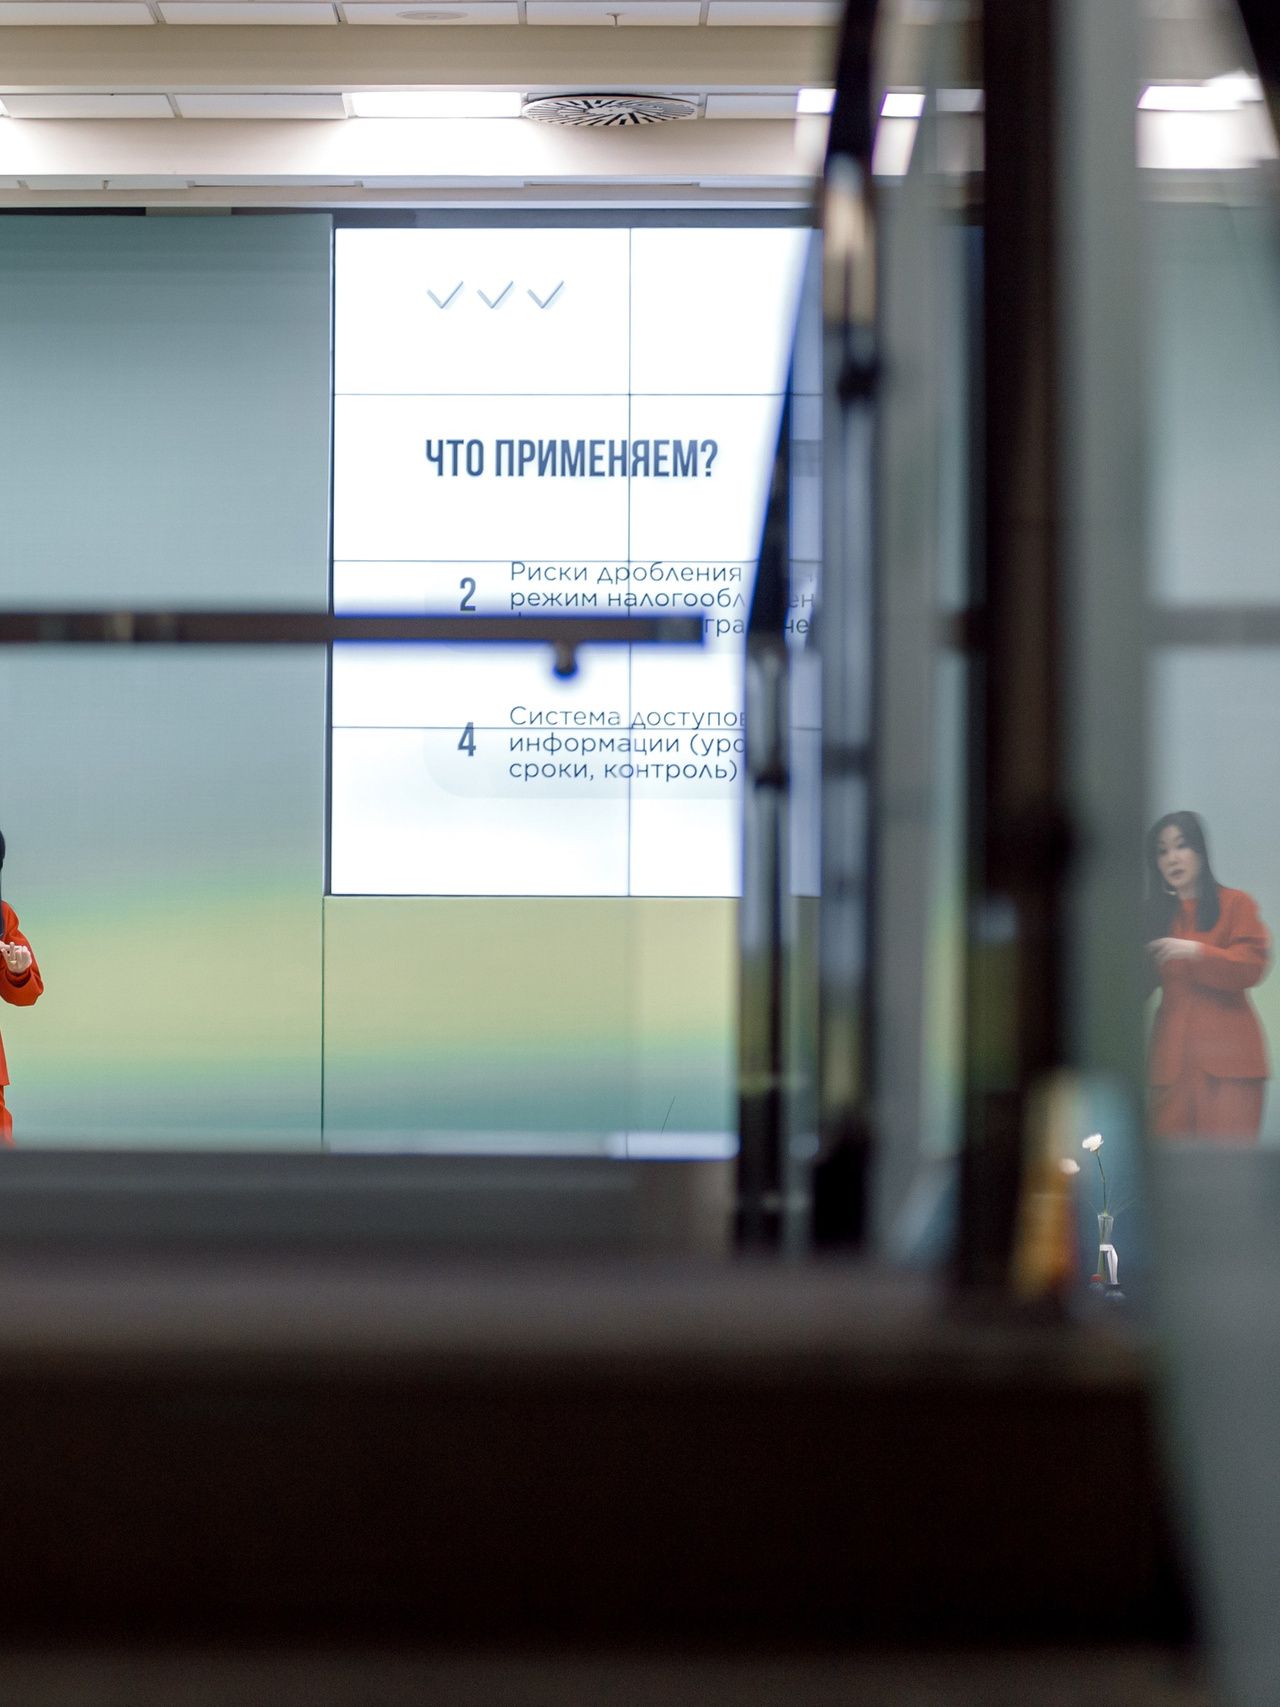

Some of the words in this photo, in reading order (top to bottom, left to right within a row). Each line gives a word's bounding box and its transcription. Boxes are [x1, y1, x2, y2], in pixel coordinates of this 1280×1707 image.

[425, 438, 484, 477] ЧТО
[494, 438, 719, 478] ПРИМЕНЯЕМ?
[511, 560, 588, 581] Риски
[596, 560, 742, 585] дробления
[459, 577, 477, 612] 2
[510, 592, 598, 611] режим
[509, 705, 621, 726] Система
[457, 721, 477, 757] 4
[509, 731, 680, 756] информации
[508, 762, 595, 782] сроки,
[604, 759, 738, 782] контроль)
